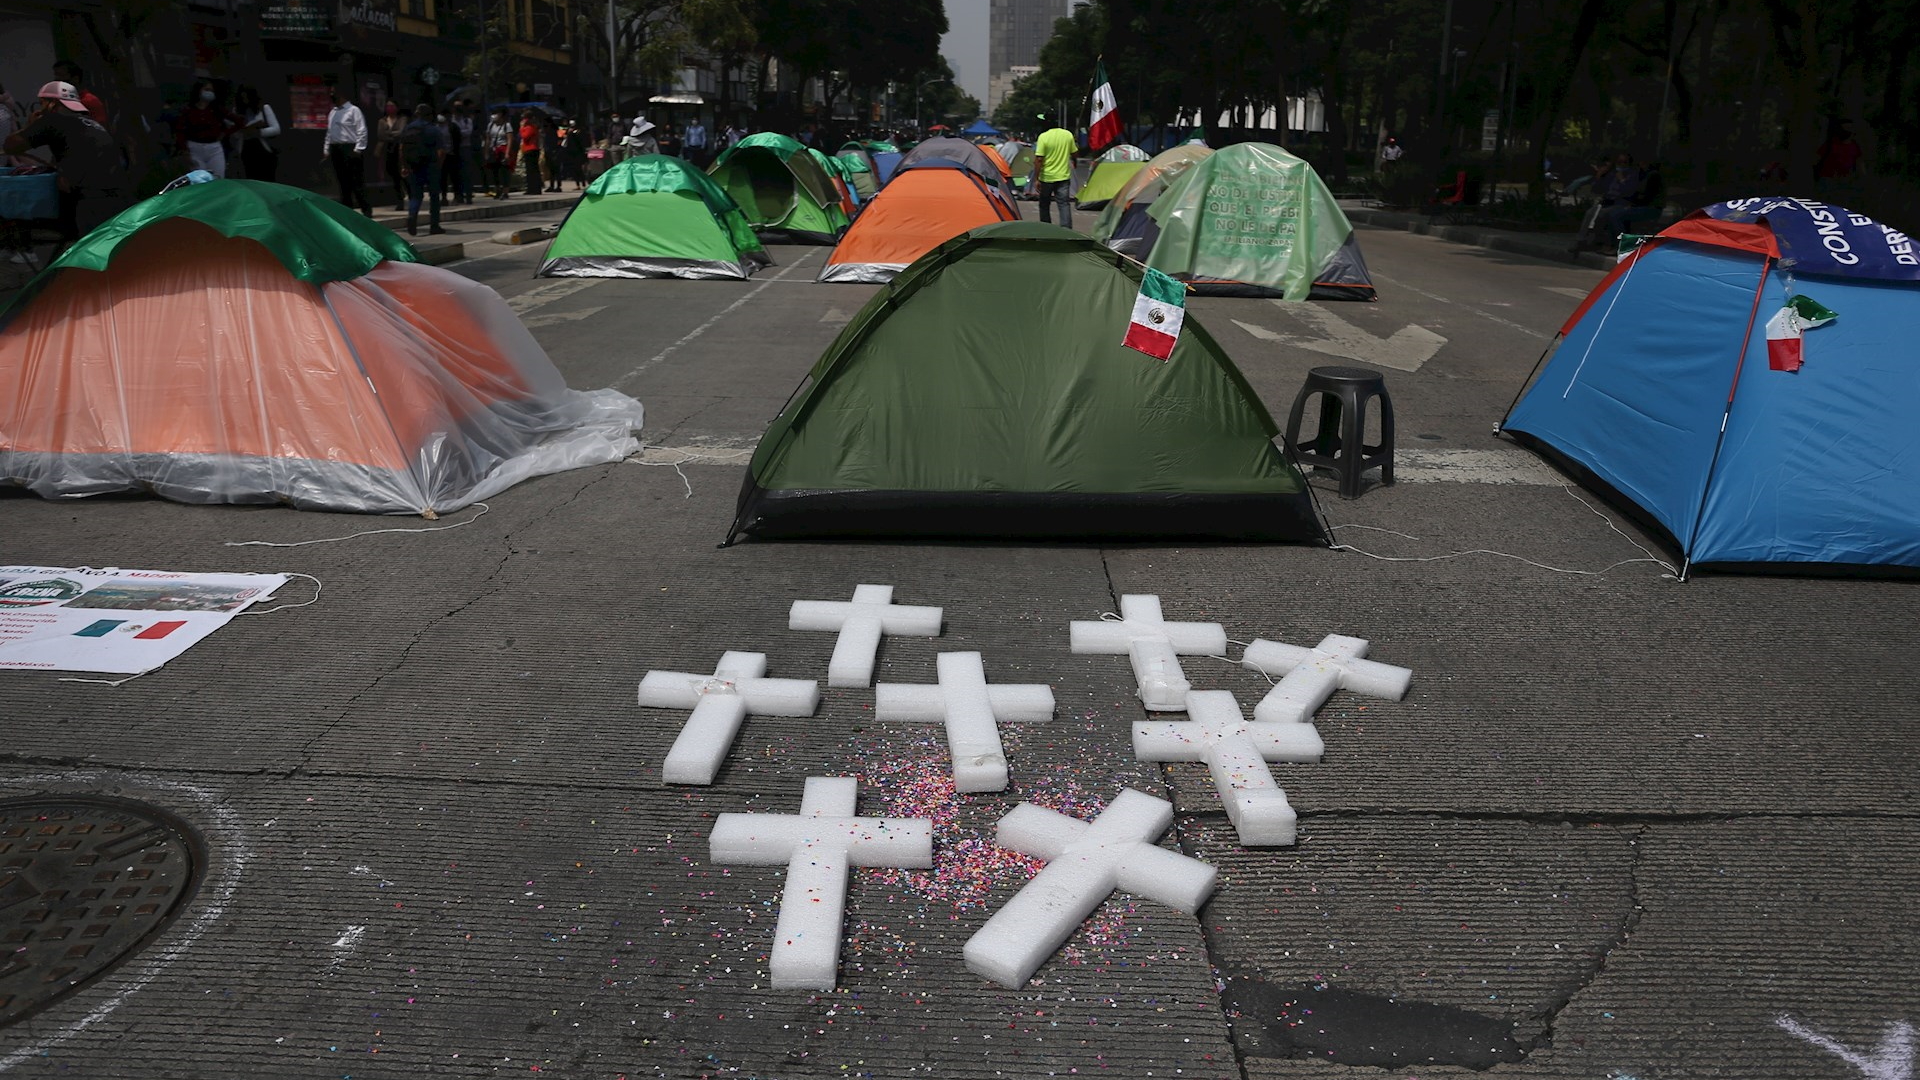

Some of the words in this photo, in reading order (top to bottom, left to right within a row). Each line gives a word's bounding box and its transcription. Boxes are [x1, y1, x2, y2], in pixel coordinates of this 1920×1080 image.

[1207, 186, 1229, 198] NO
[1232, 188, 1249, 199] DE
[1209, 203, 1237, 215] QUE
[1245, 205, 1258, 216] EL
[1215, 220, 1237, 231] NO
[1240, 221, 1255, 232] LE
[1259, 222, 1276, 233] DE
[1278, 223, 1297, 235] PA
